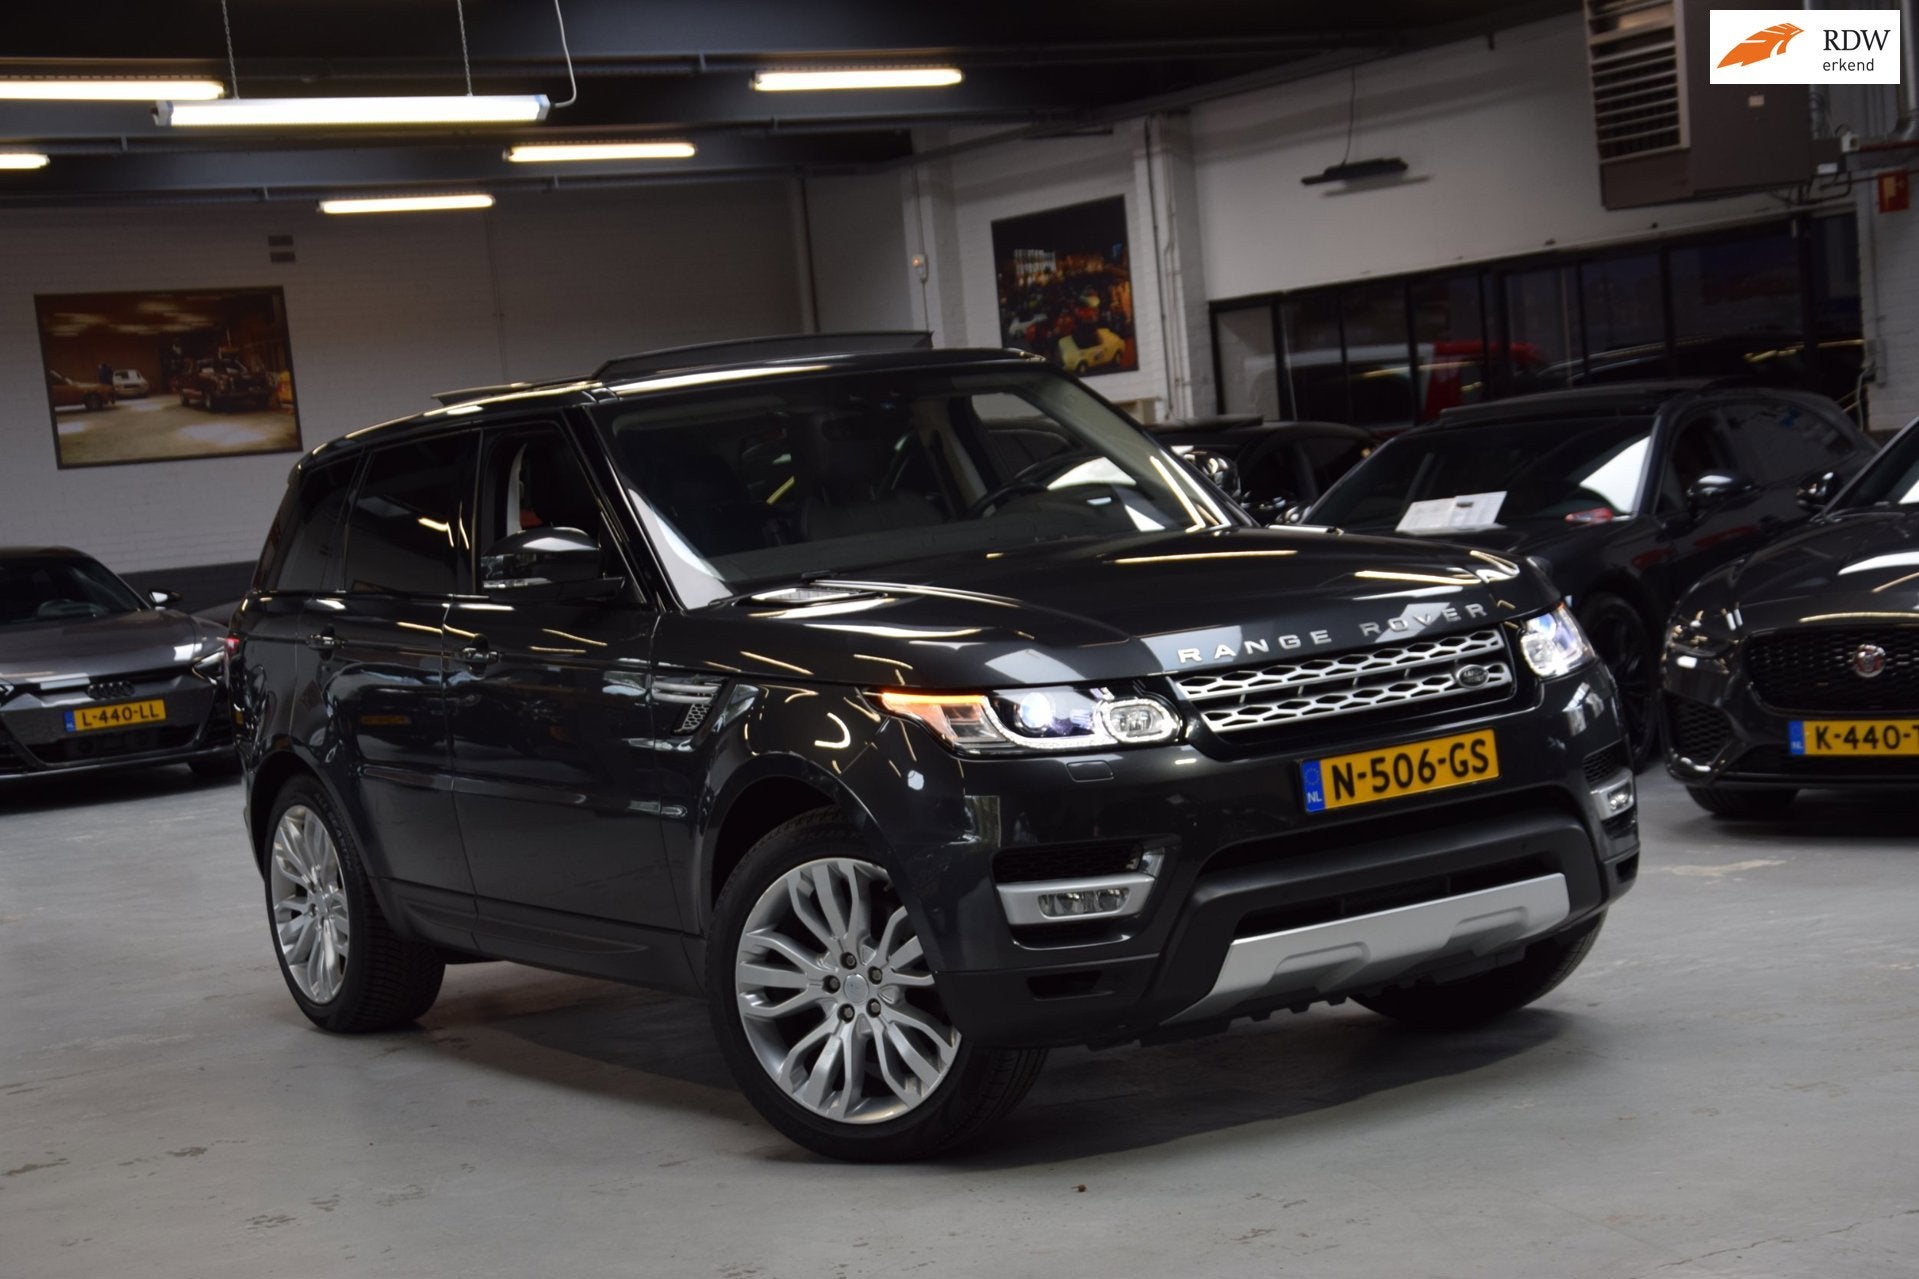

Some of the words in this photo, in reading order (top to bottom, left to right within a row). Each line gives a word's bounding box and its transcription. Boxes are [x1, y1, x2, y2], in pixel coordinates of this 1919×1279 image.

[1177, 629, 1332, 664] RANGE
[1359, 603, 1488, 637] ROVER
[82, 704, 160, 728] L-440-LL
[1306, 790, 1323, 803] NL
[1331, 738, 1490, 802] N-506-GS
